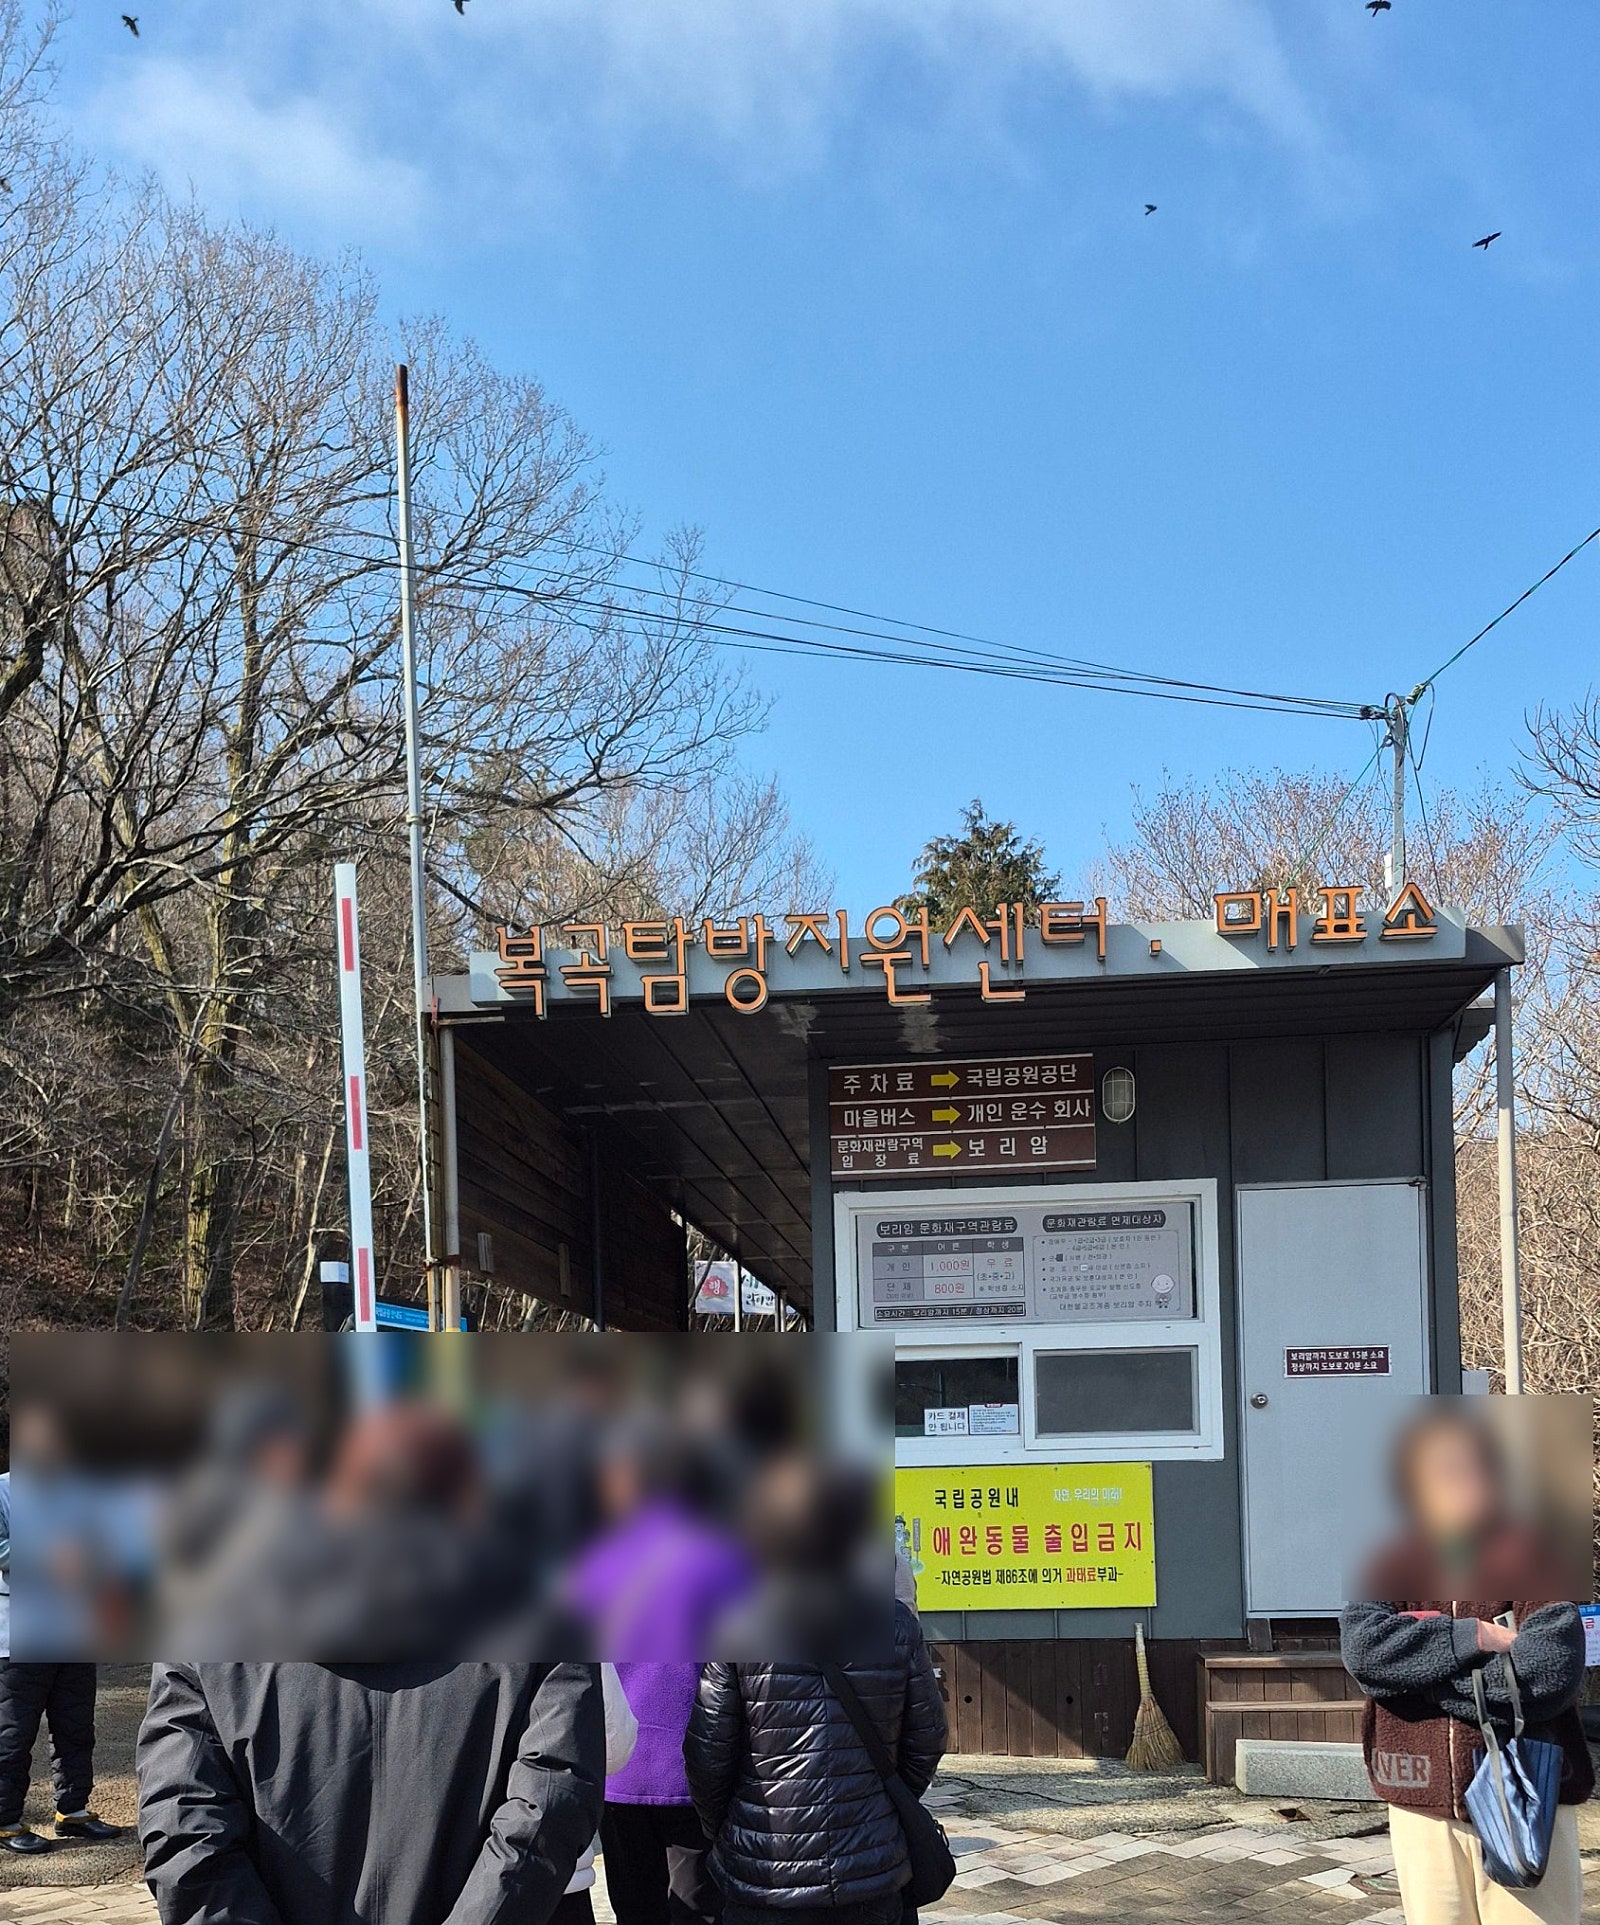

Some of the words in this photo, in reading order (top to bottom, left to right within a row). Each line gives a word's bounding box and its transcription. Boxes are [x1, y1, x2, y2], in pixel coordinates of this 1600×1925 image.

[495, 897, 1106, 1018] 복곡탐방지원센터
[1213, 882, 1438, 951] 매표소
[966, 1063, 1077, 1087] 국립공원공단
[844, 1108, 916, 1129] 마을버스
[967, 1103, 1003, 1122] 개인
[1010, 1101, 1047, 1120] 운수
[1053, 1098, 1091, 1118] 회사
[837, 1136, 924, 1153] 문화재관람구역
[879, 1223, 914, 1236] 보리암
[919, 1219, 1015, 1235] 문화재구역관람료
[934, 1282, 965, 1294] 800원
[1291, 1351, 1327, 1361] 보리암까지
[1327, 1351, 1350, 1360] 도보로
[1352, 1350, 1368, 1360] 15분
[1370, 1350, 1385, 1359] 소요
[1290, 1362, 1320, 1372] 정상까지
[1321, 1361, 1343, 1371] 도보로
[1344, 1361, 1361, 1371] 20분
[1362, 1360, 1378, 1370] 소요
[928, 1411, 946, 1421] 카드
[948, 1411, 965, 1420] 결제
[928, 1422, 937, 1432] 안
[940, 1422, 965, 1432] 됩니다
[934, 1487, 1019, 1509] 국립공원내
[933, 1525, 1030, 1556] 애완동물
[1043, 1521, 1142, 1554] 출입금지
[995, 1568, 1038, 1584] 제86조에
[1042, 1567, 1062, 1584] 의거
